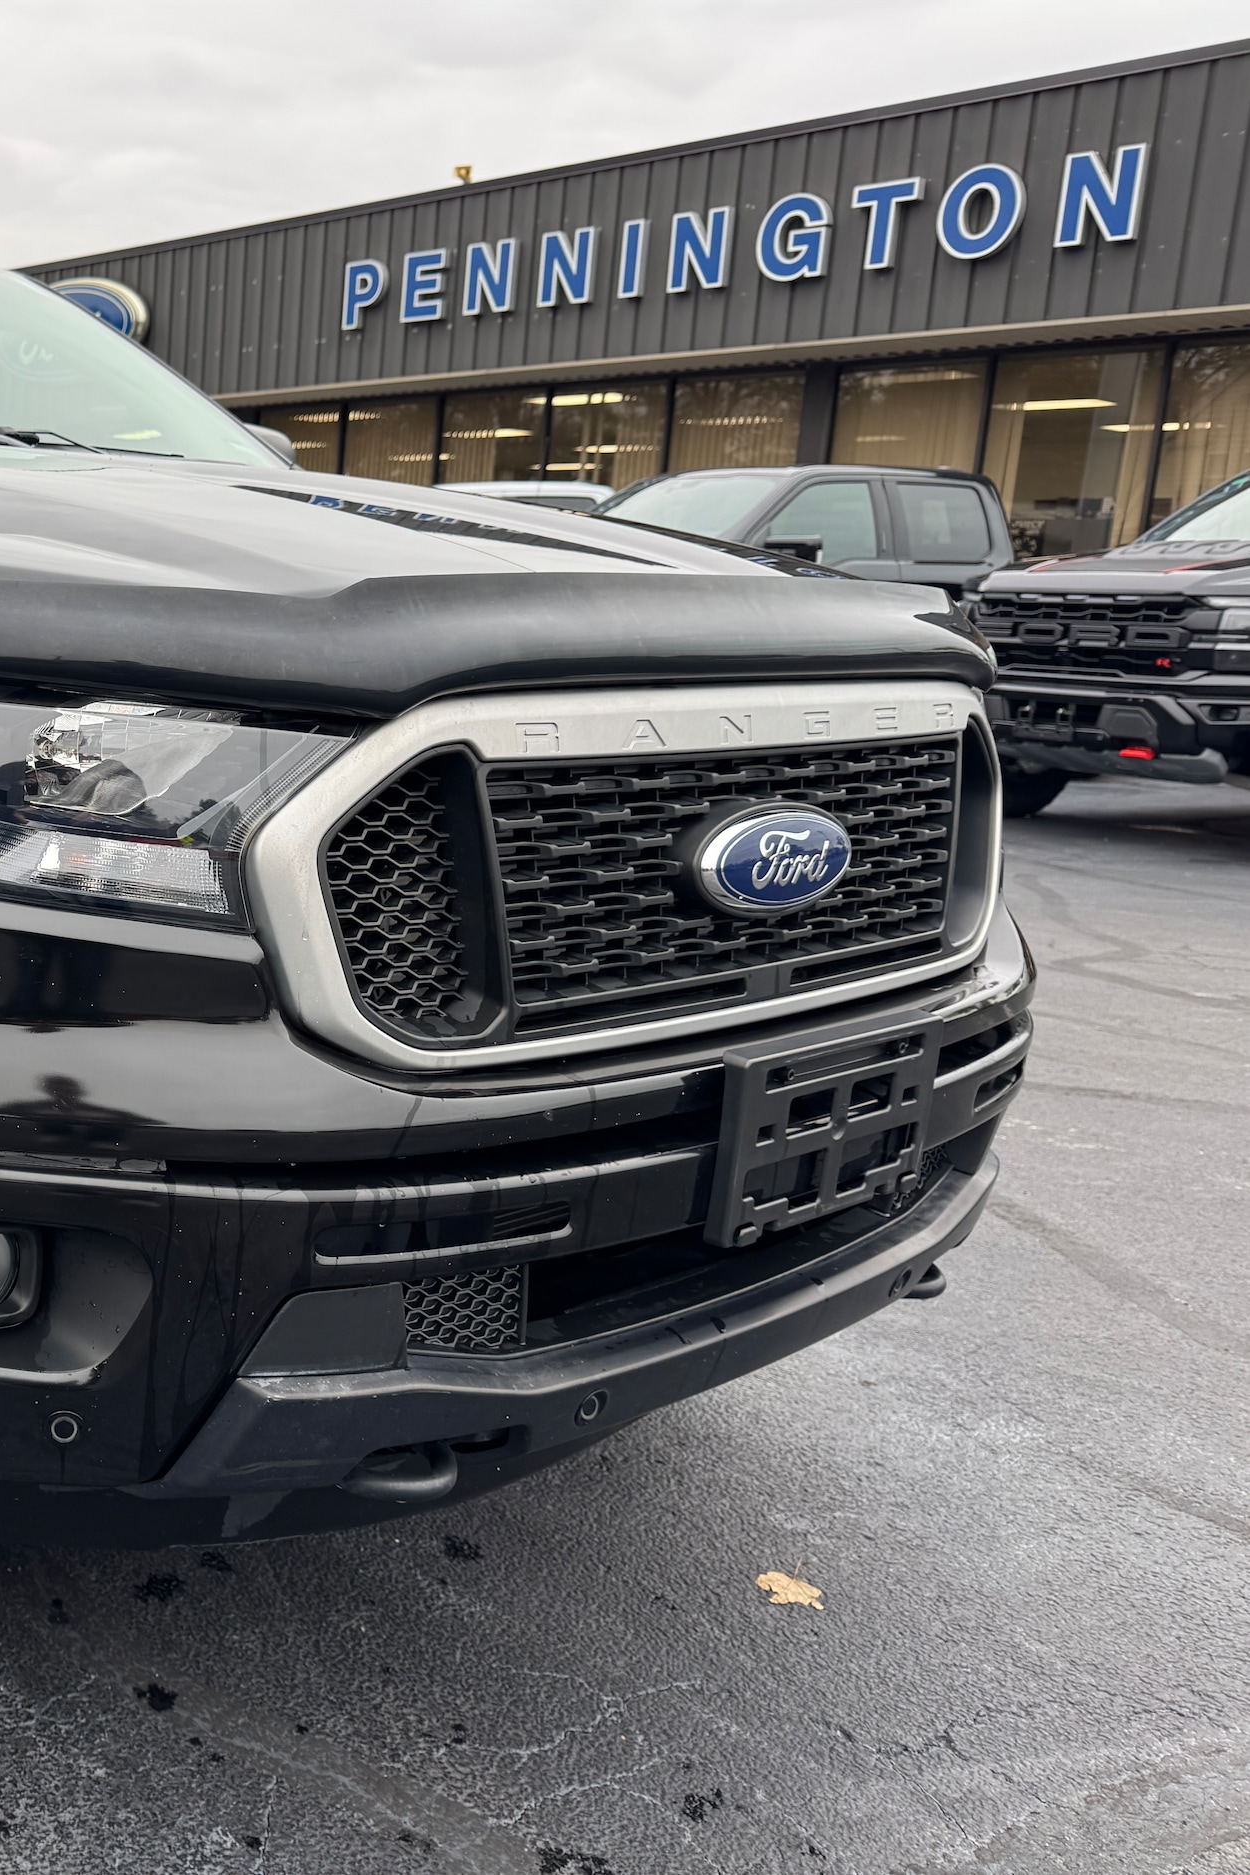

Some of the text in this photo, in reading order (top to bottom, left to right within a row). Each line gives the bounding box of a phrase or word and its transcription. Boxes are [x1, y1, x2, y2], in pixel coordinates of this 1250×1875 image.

[341, 142, 1149, 331] PENNINGTON
[515, 702, 955, 754] RANGER
[751, 829, 830, 890] Ford
